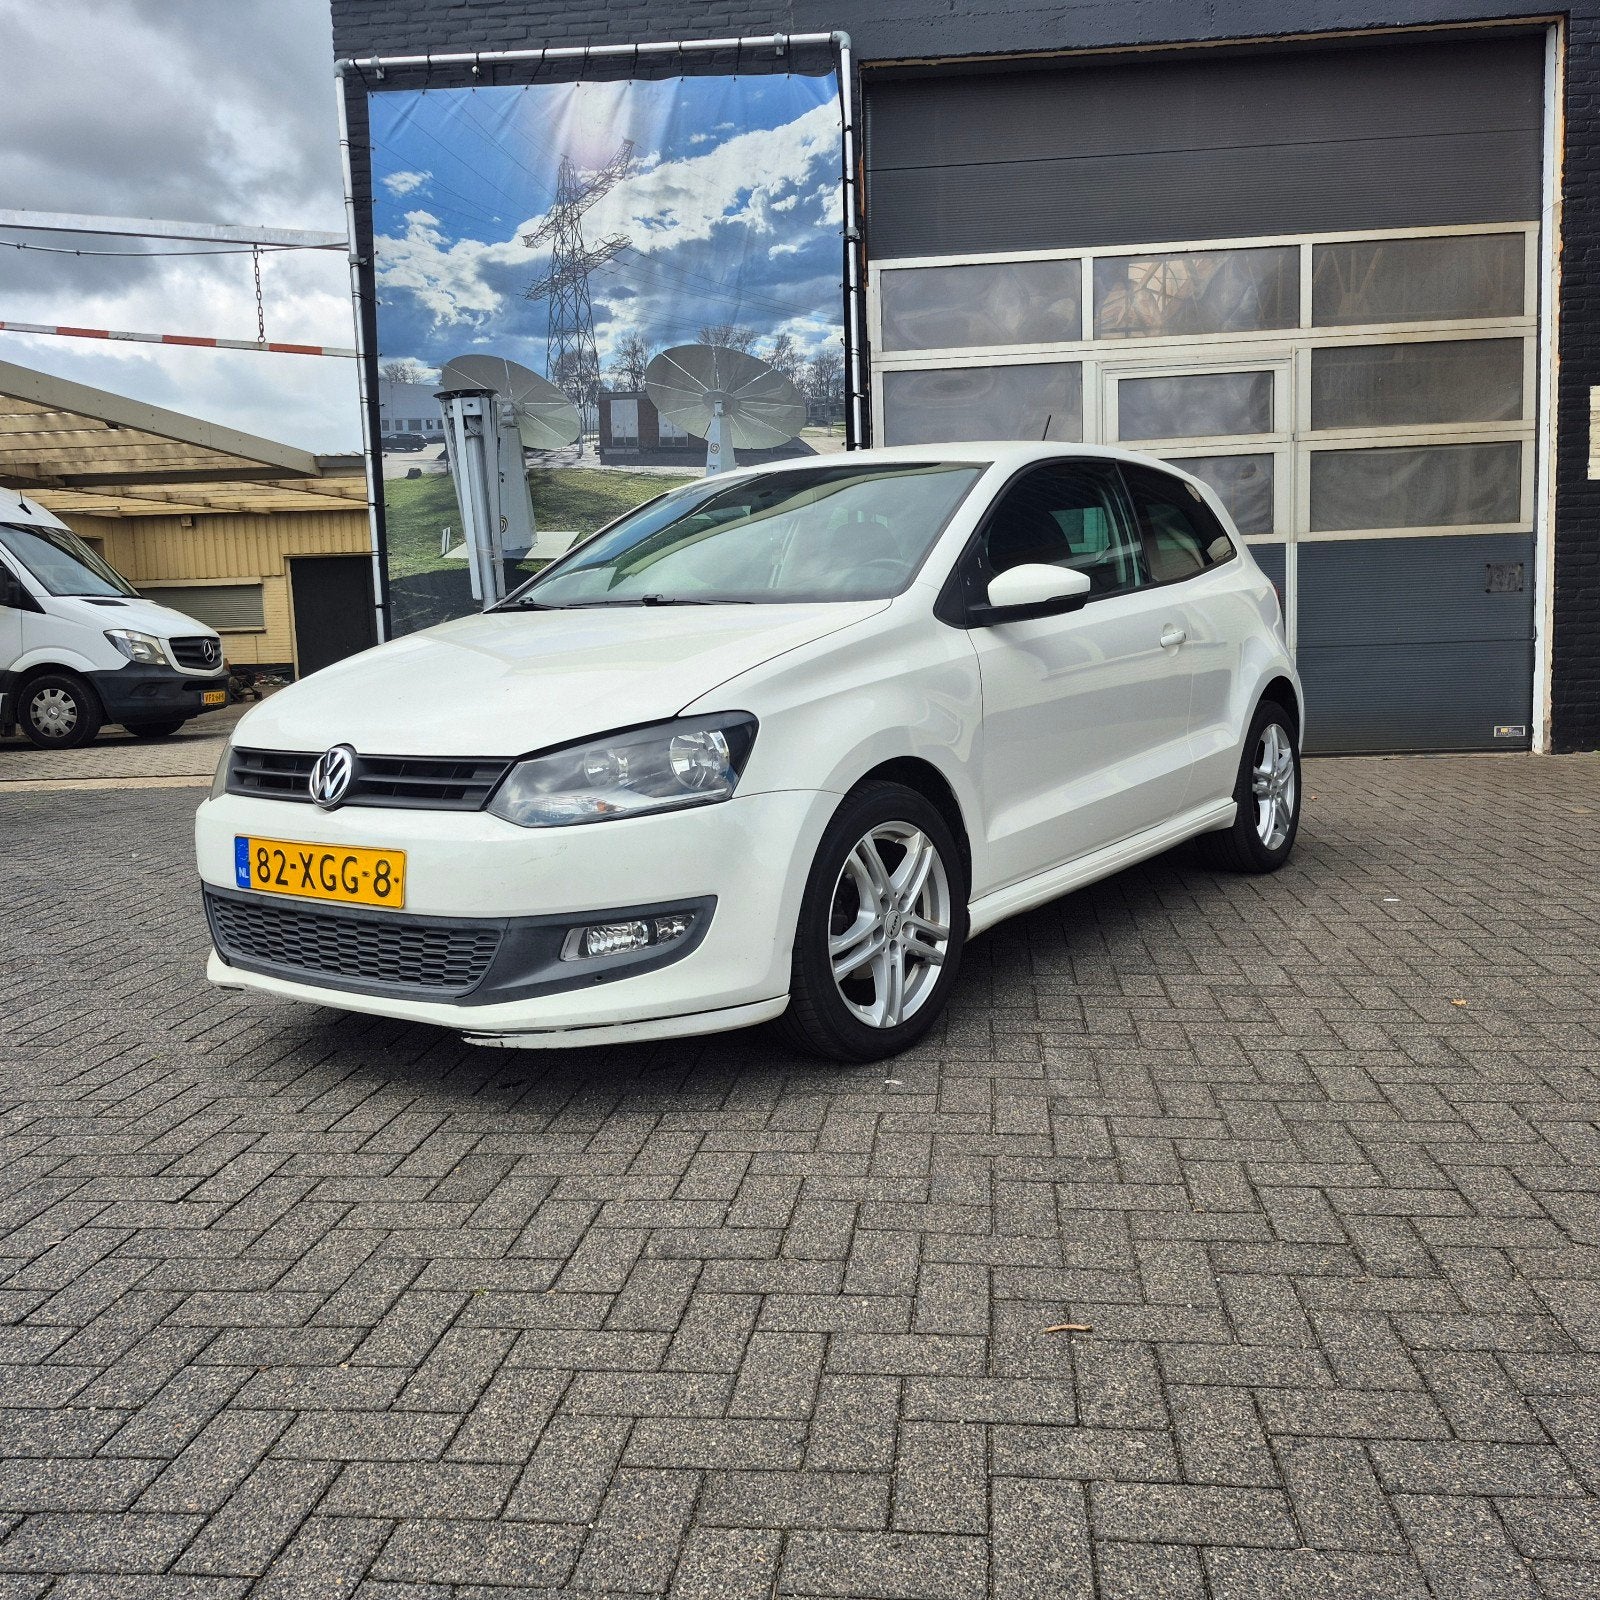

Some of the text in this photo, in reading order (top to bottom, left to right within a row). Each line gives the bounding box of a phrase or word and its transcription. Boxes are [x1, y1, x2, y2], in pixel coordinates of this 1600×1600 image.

[310, 748, 352, 803] VW
[238, 866, 249, 879] NL
[257, 847, 392, 898] 82-XGG-8
